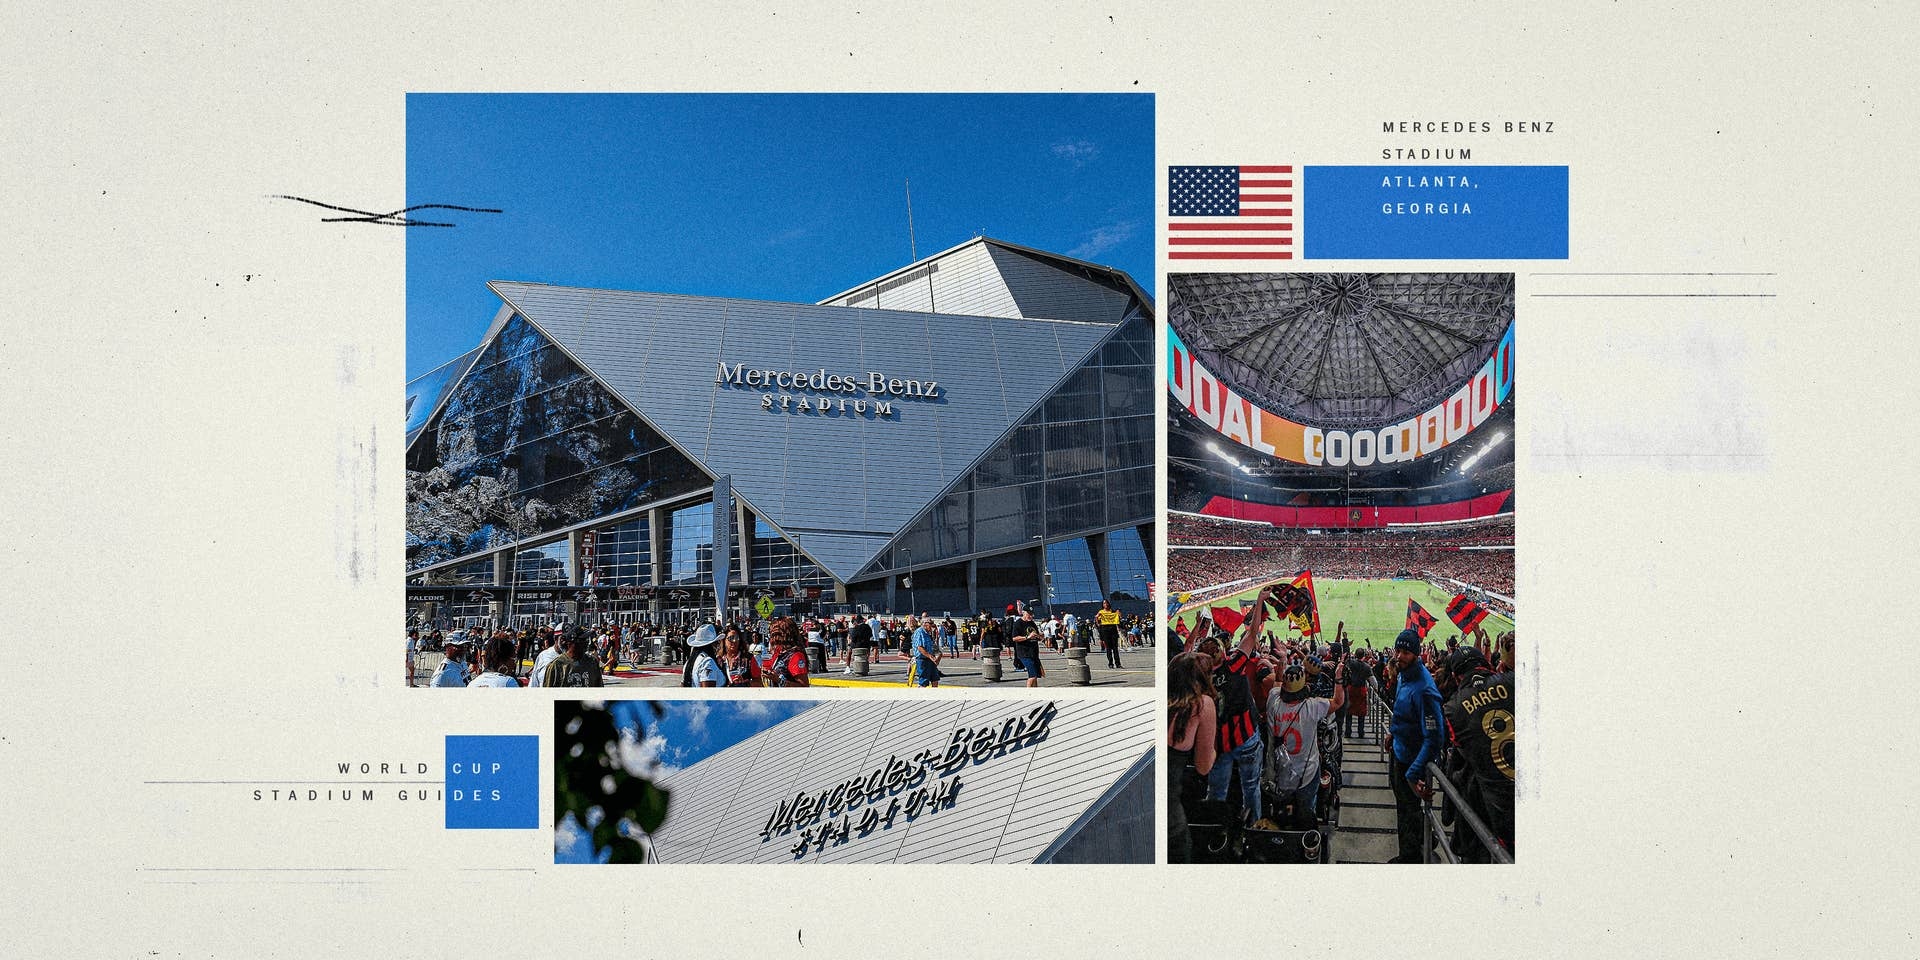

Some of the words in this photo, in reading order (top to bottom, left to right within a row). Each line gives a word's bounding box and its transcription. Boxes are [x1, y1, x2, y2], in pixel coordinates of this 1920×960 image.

[715, 361, 939, 398] Mercedes-Benz
[761, 394, 893, 415] STADIUM
[1462, 685, 1508, 714] BARCO
[1482, 709, 1515, 781] 8
[760, 702, 1058, 840] Mercedes-Benz
